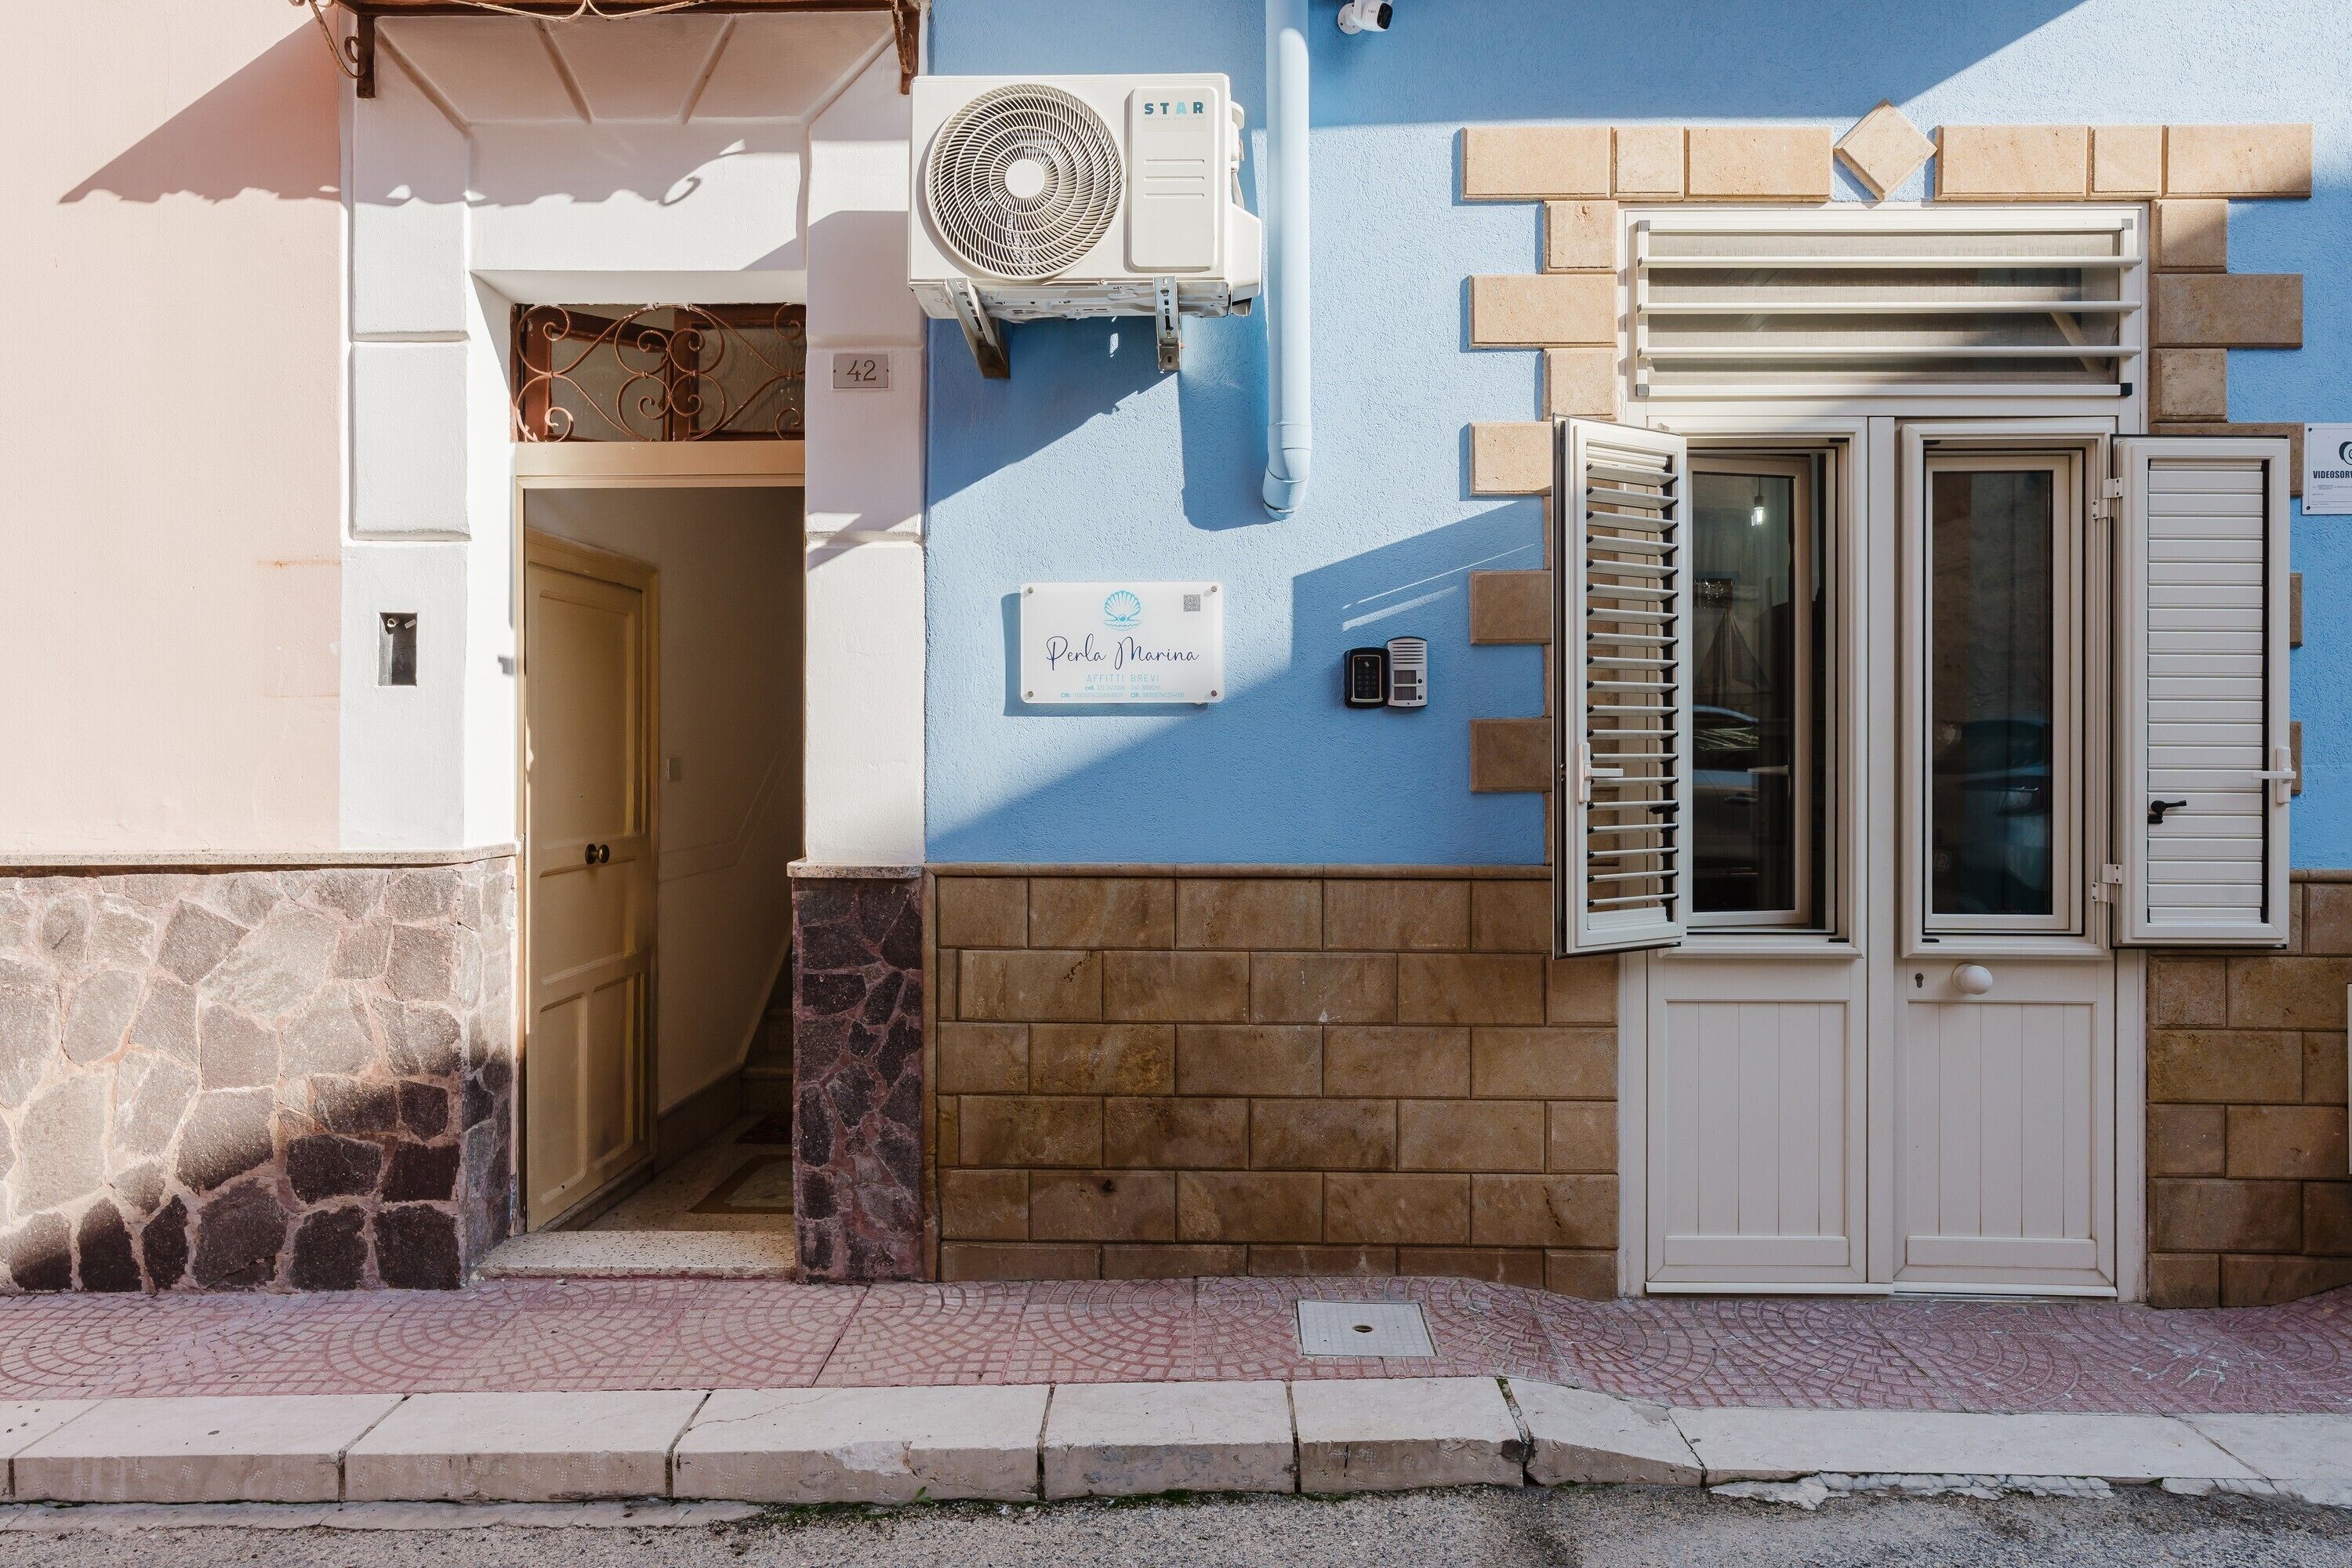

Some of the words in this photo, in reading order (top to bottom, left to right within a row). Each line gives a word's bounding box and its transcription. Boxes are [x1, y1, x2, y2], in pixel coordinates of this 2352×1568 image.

[1144, 101, 1204, 115] STAR
[846, 360, 877, 382] 42
[1046, 633, 1107, 671] Perla
[1114, 636, 1200, 670] Marina
[1086, 674, 1124, 683] AFFITTI
[1131, 674, 1160, 683] BREVI
